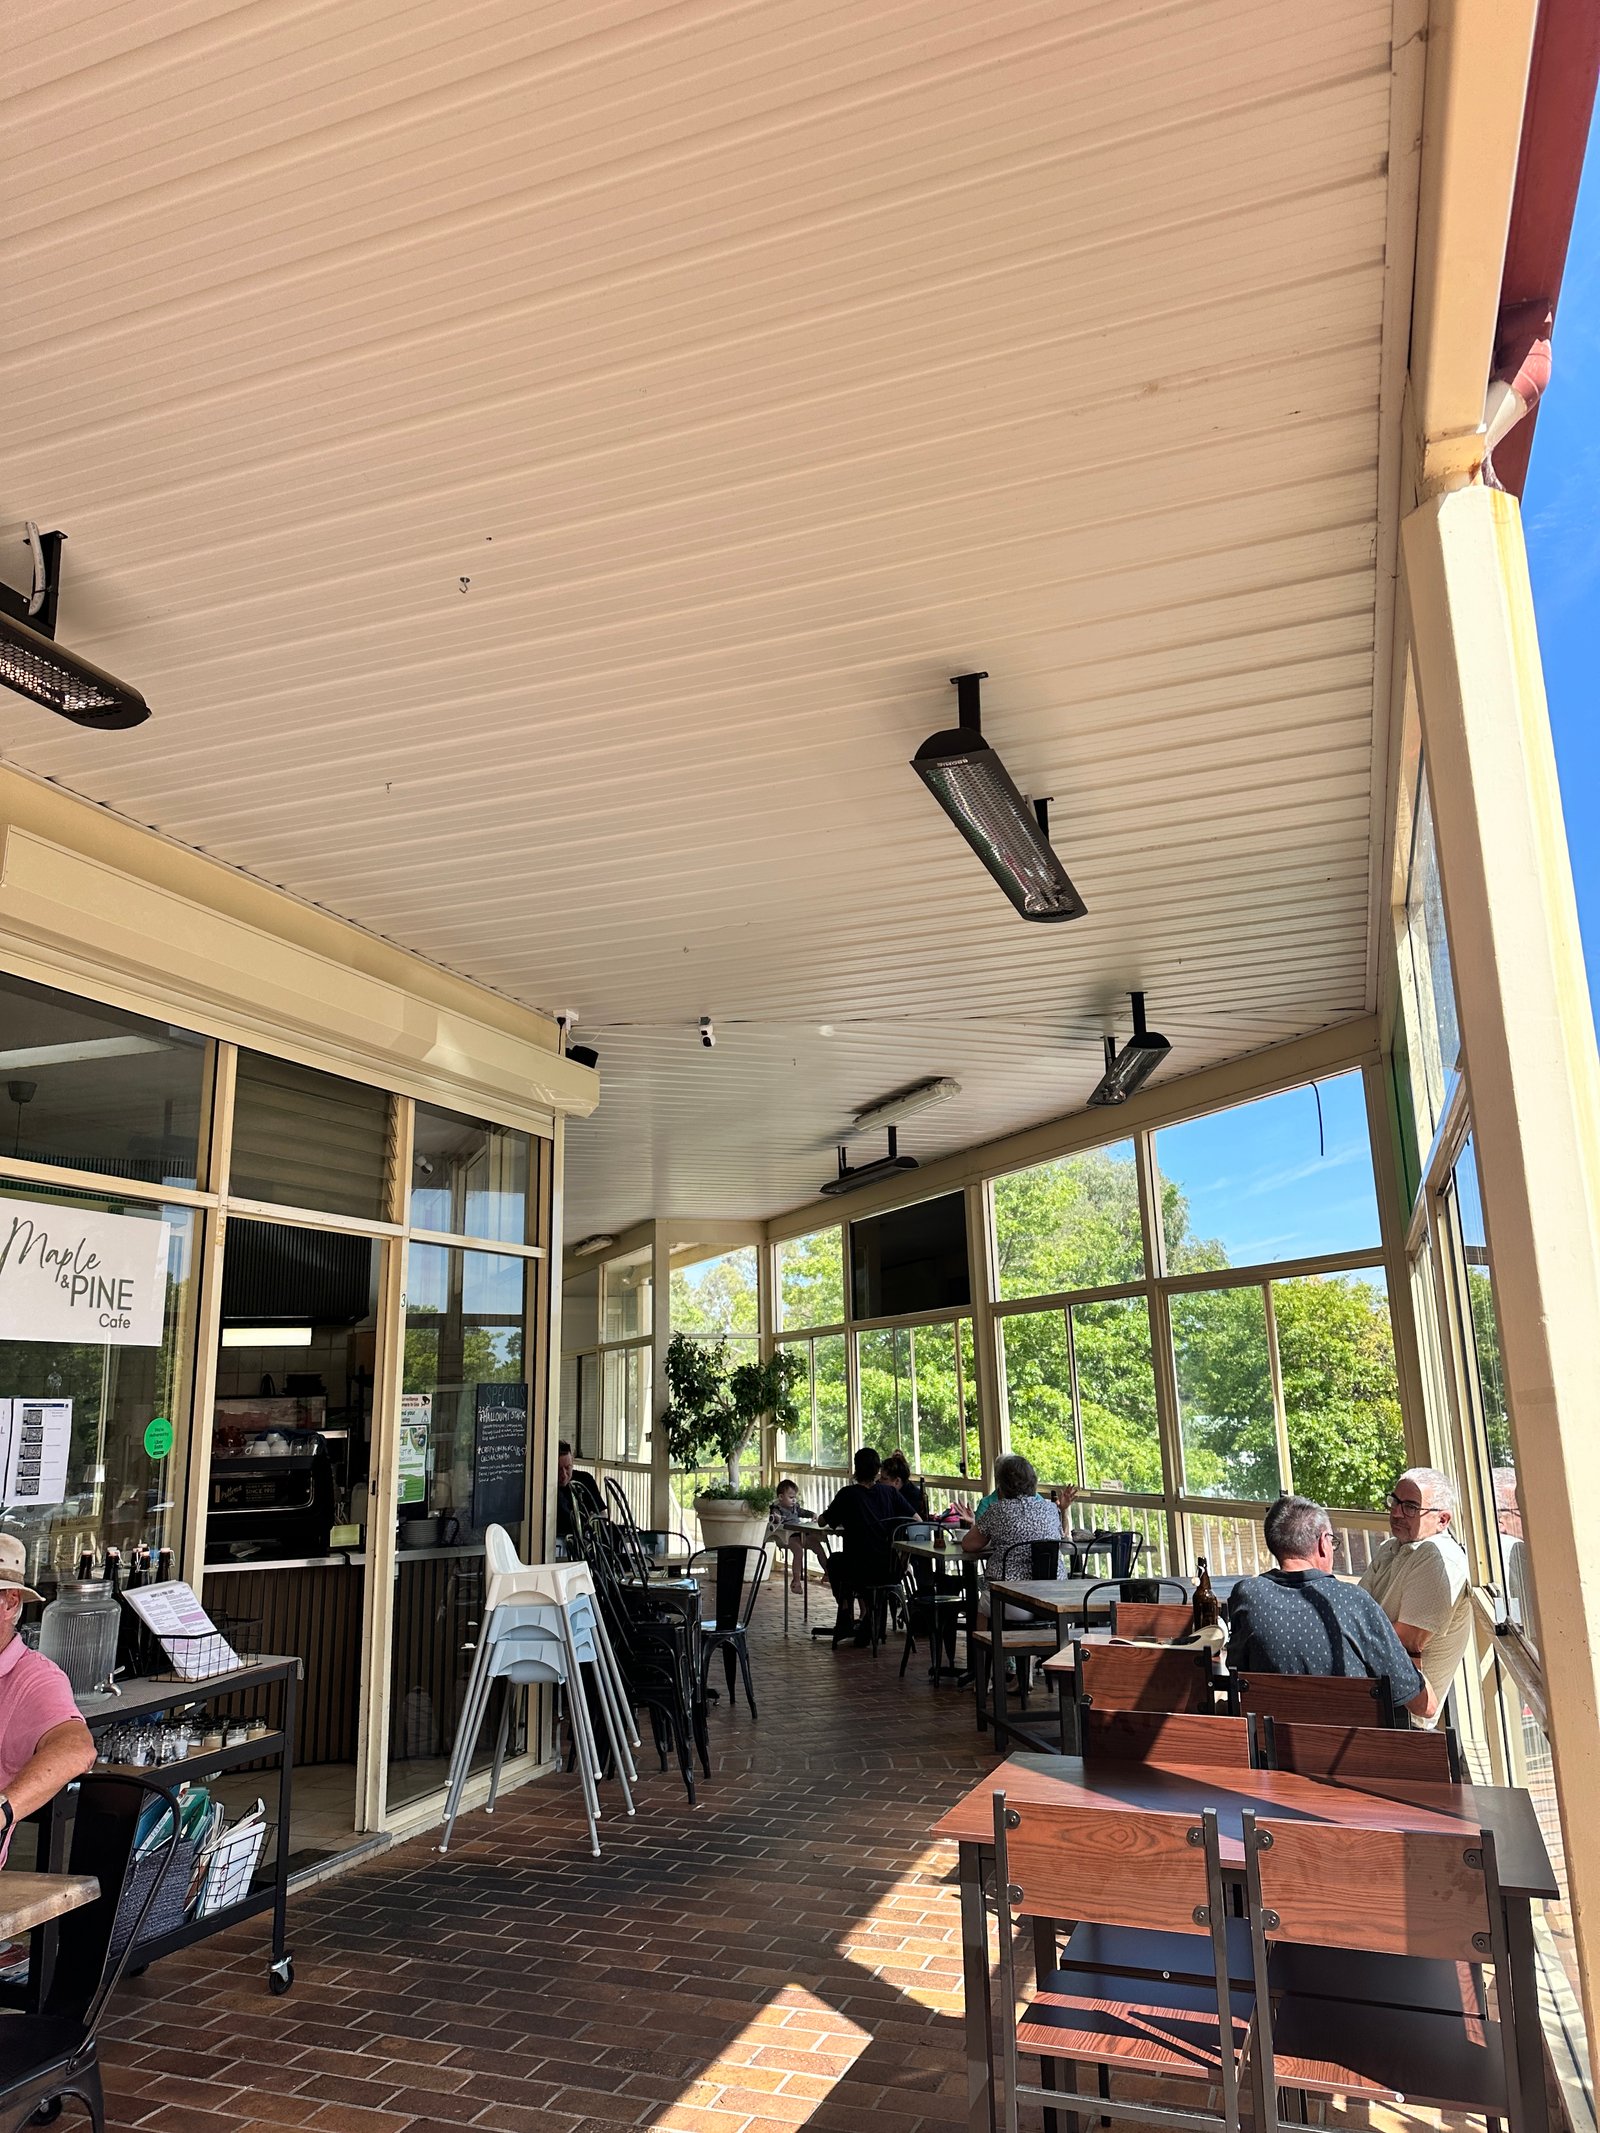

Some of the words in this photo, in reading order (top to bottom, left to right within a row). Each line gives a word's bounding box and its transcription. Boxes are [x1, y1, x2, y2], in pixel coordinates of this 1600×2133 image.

[0, 1216, 101, 1283] Maple
[98, 1313, 131, 1328] Cafe
[486, 1385, 526, 1408] SPECIALS
